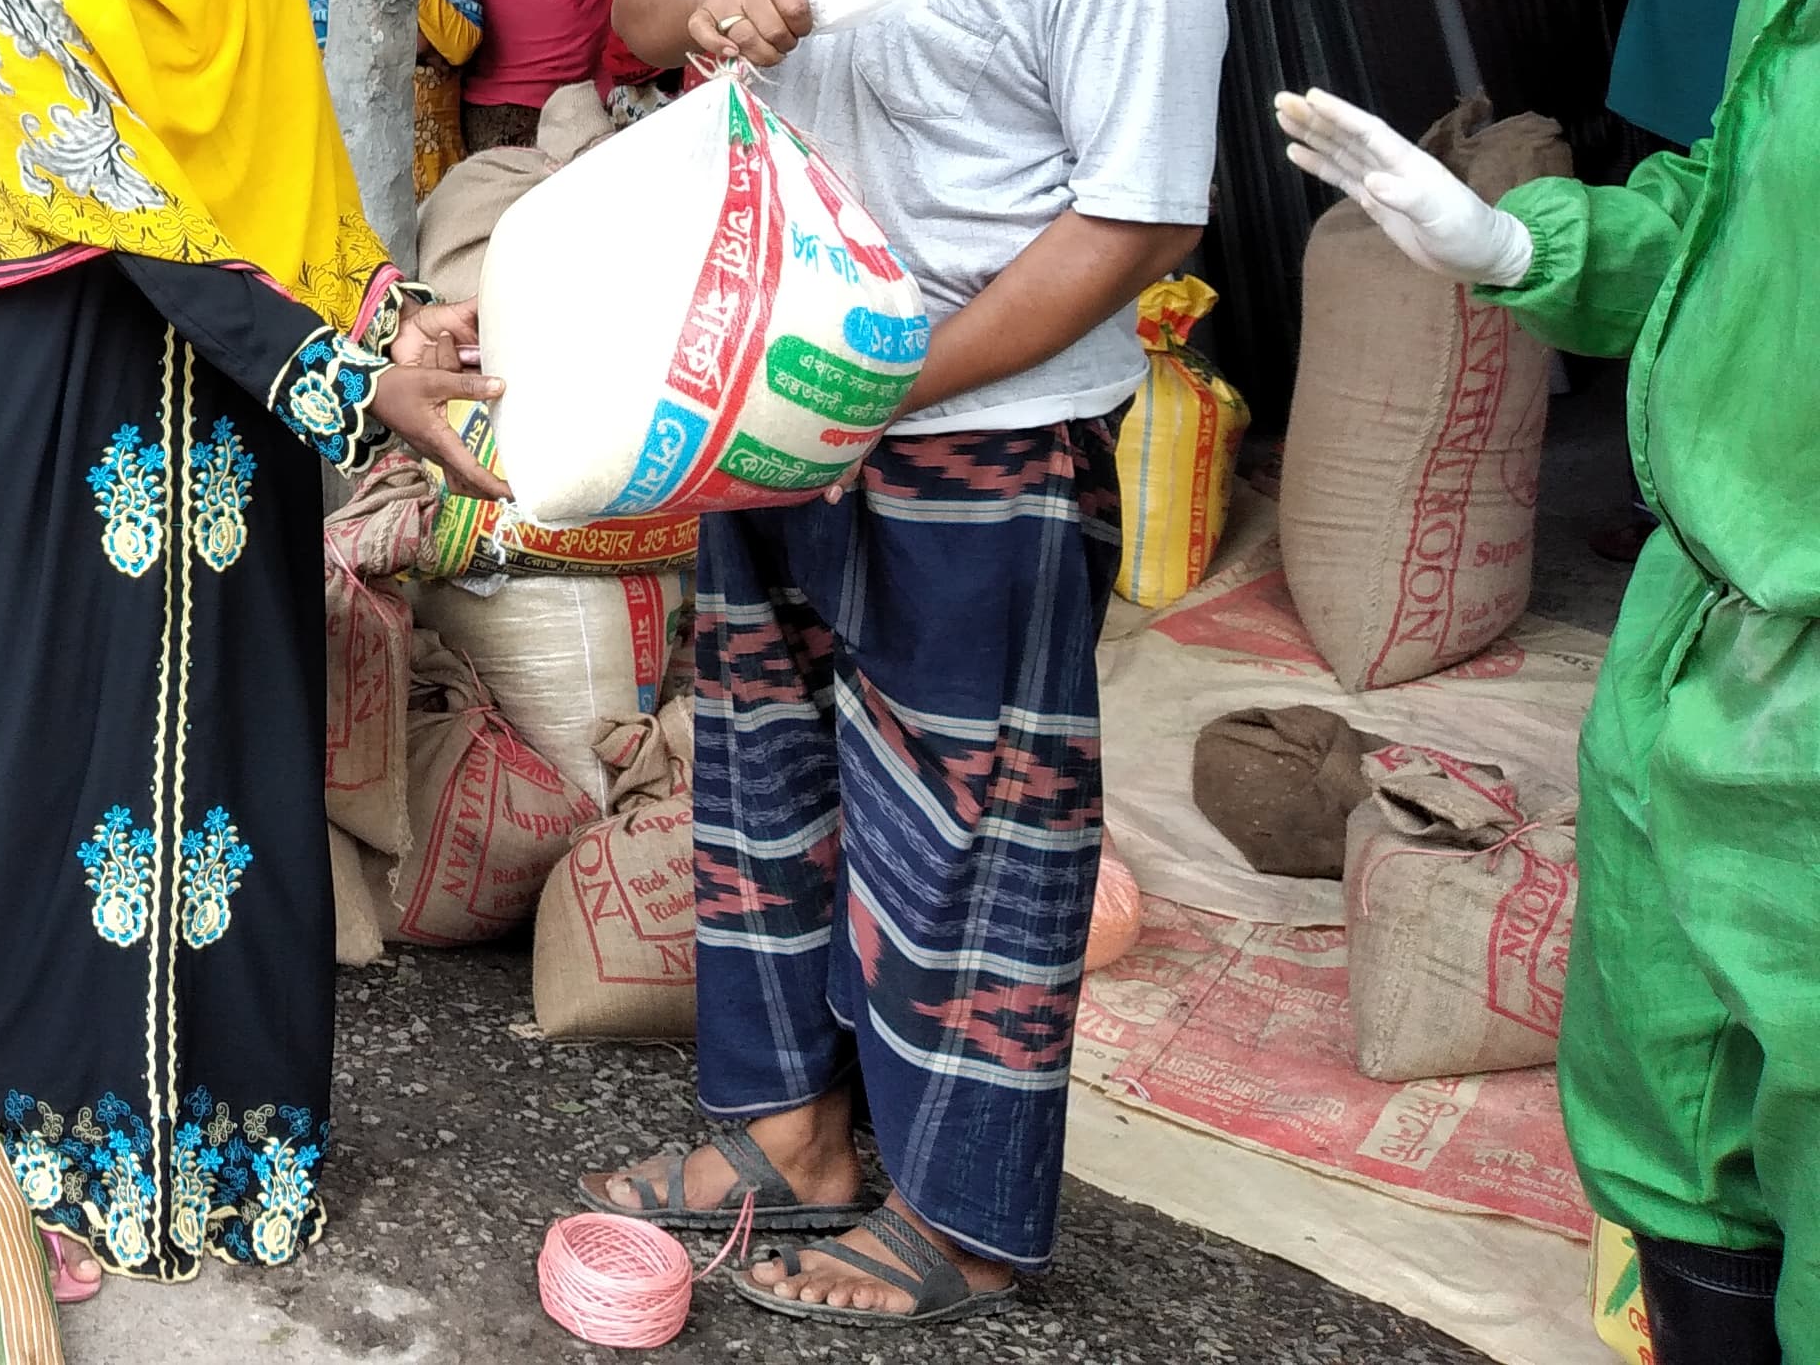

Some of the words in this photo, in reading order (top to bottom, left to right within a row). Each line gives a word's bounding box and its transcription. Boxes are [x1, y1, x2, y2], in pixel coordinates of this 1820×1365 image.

[674, 288, 740, 393] মার্কা
[799, 352, 846, 385] এখানে
[1396, 305, 1507, 646] NOORJAHAN
[441, 733, 490, 900] OORJAHAN
[627, 809, 693, 838] upe
